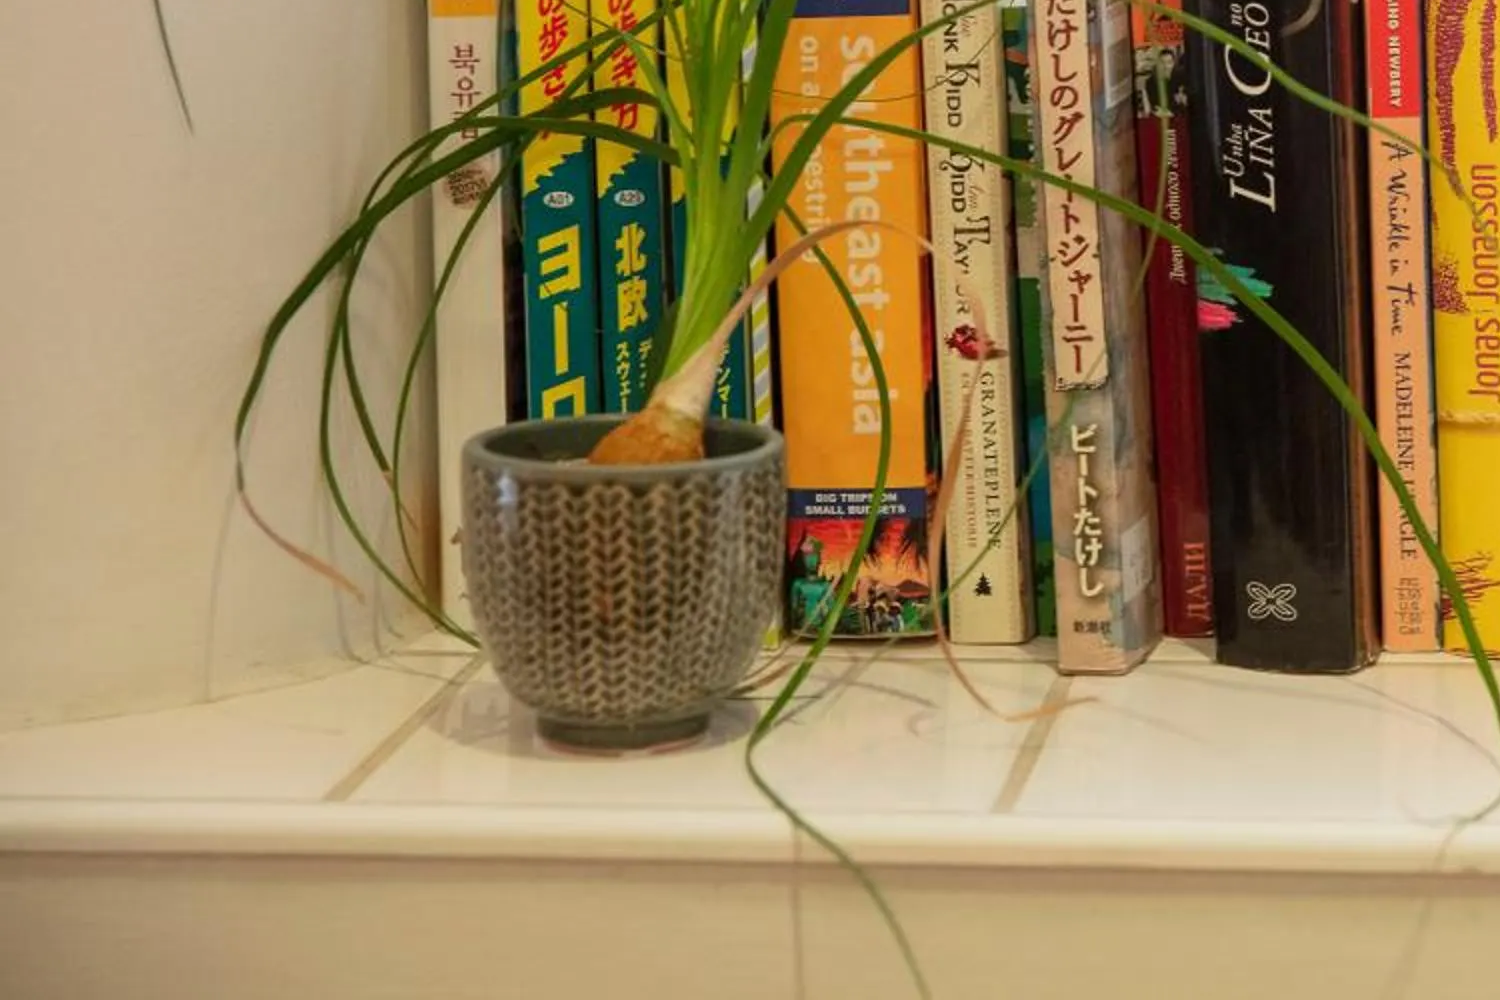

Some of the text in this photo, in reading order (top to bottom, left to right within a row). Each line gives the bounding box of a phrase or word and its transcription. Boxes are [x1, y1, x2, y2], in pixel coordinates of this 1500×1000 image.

[800, 36, 820, 72] on
[1230, 3, 1243, 27] no
[936, 59, 981, 128] KIDD
[1387, 35, 1403, 108] NEWBERY
[1223, 123, 1245, 178] Unha
[1229, 107, 1277, 213] LIÑA
[614, 221, 649, 333] 北欧
[953, 215, 992, 315] TAYR
[1381, 140, 1418, 337] A Wrinkle in Time
[1393, 352, 1415, 473] MADELEINE
[815, 493, 837, 503] BIG
[979, 371, 1002, 550] GRANATEPLENE
[805, 505, 845, 515] SMALL
[1070, 422, 1104, 598] ビートたけし
